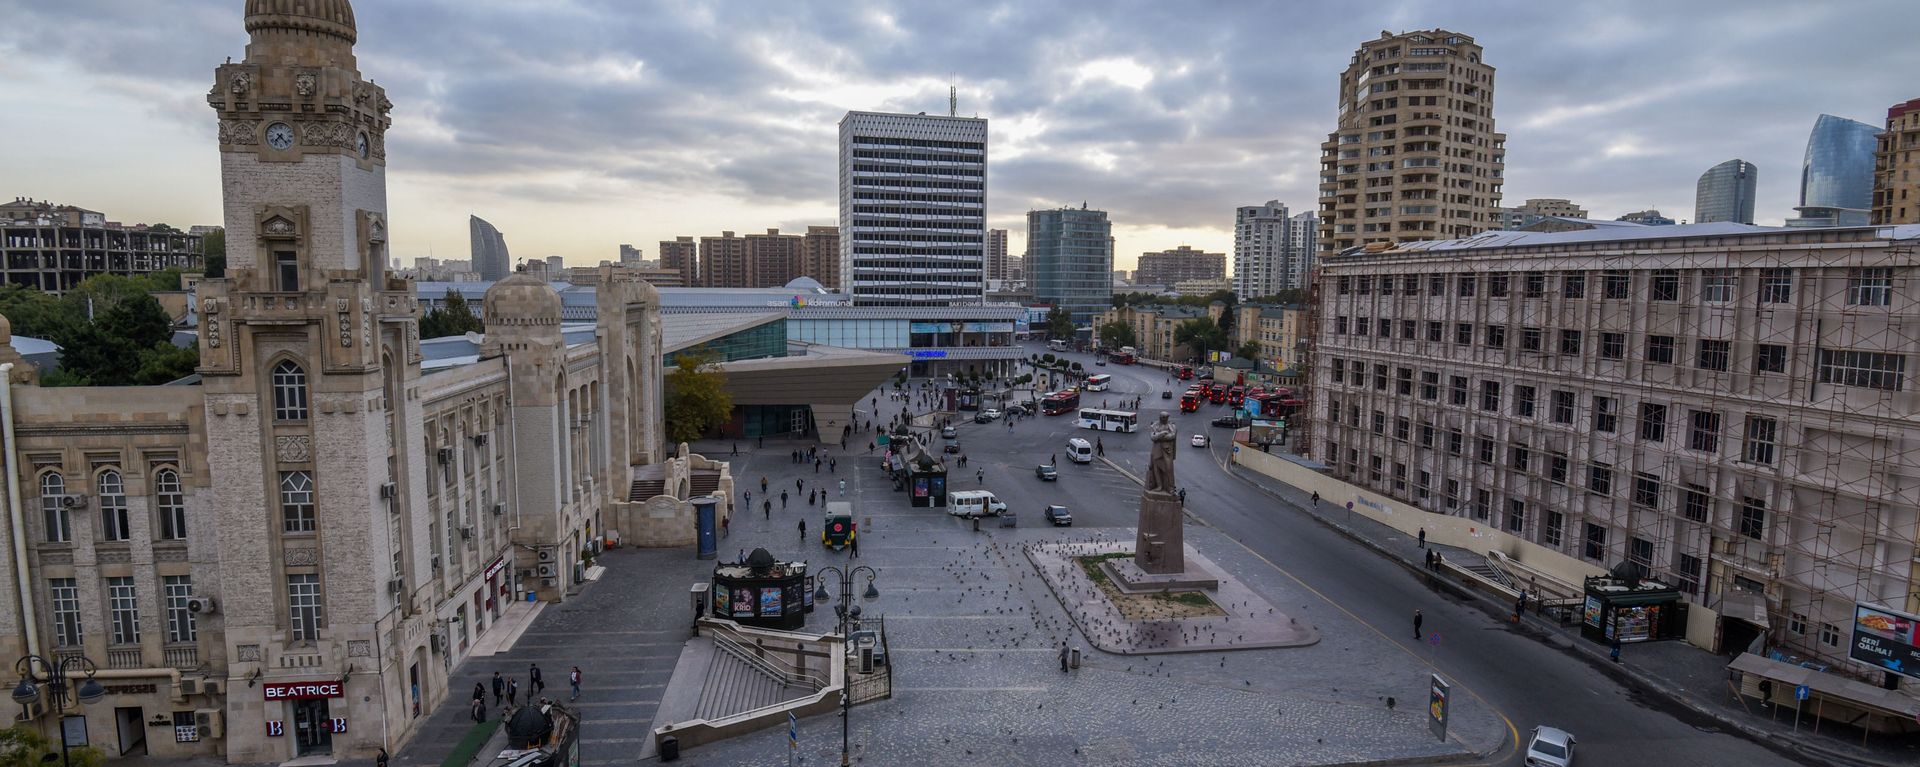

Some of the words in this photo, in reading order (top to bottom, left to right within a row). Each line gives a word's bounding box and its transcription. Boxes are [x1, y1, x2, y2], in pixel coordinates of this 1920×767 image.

[807, 298, 853, 307] kommunal
[1861, 637, 1880, 647] GERİ
[265, 684, 340, 697] BEATRICE
[269, 720, 283, 736] B
[332, 718, 346, 733] B
